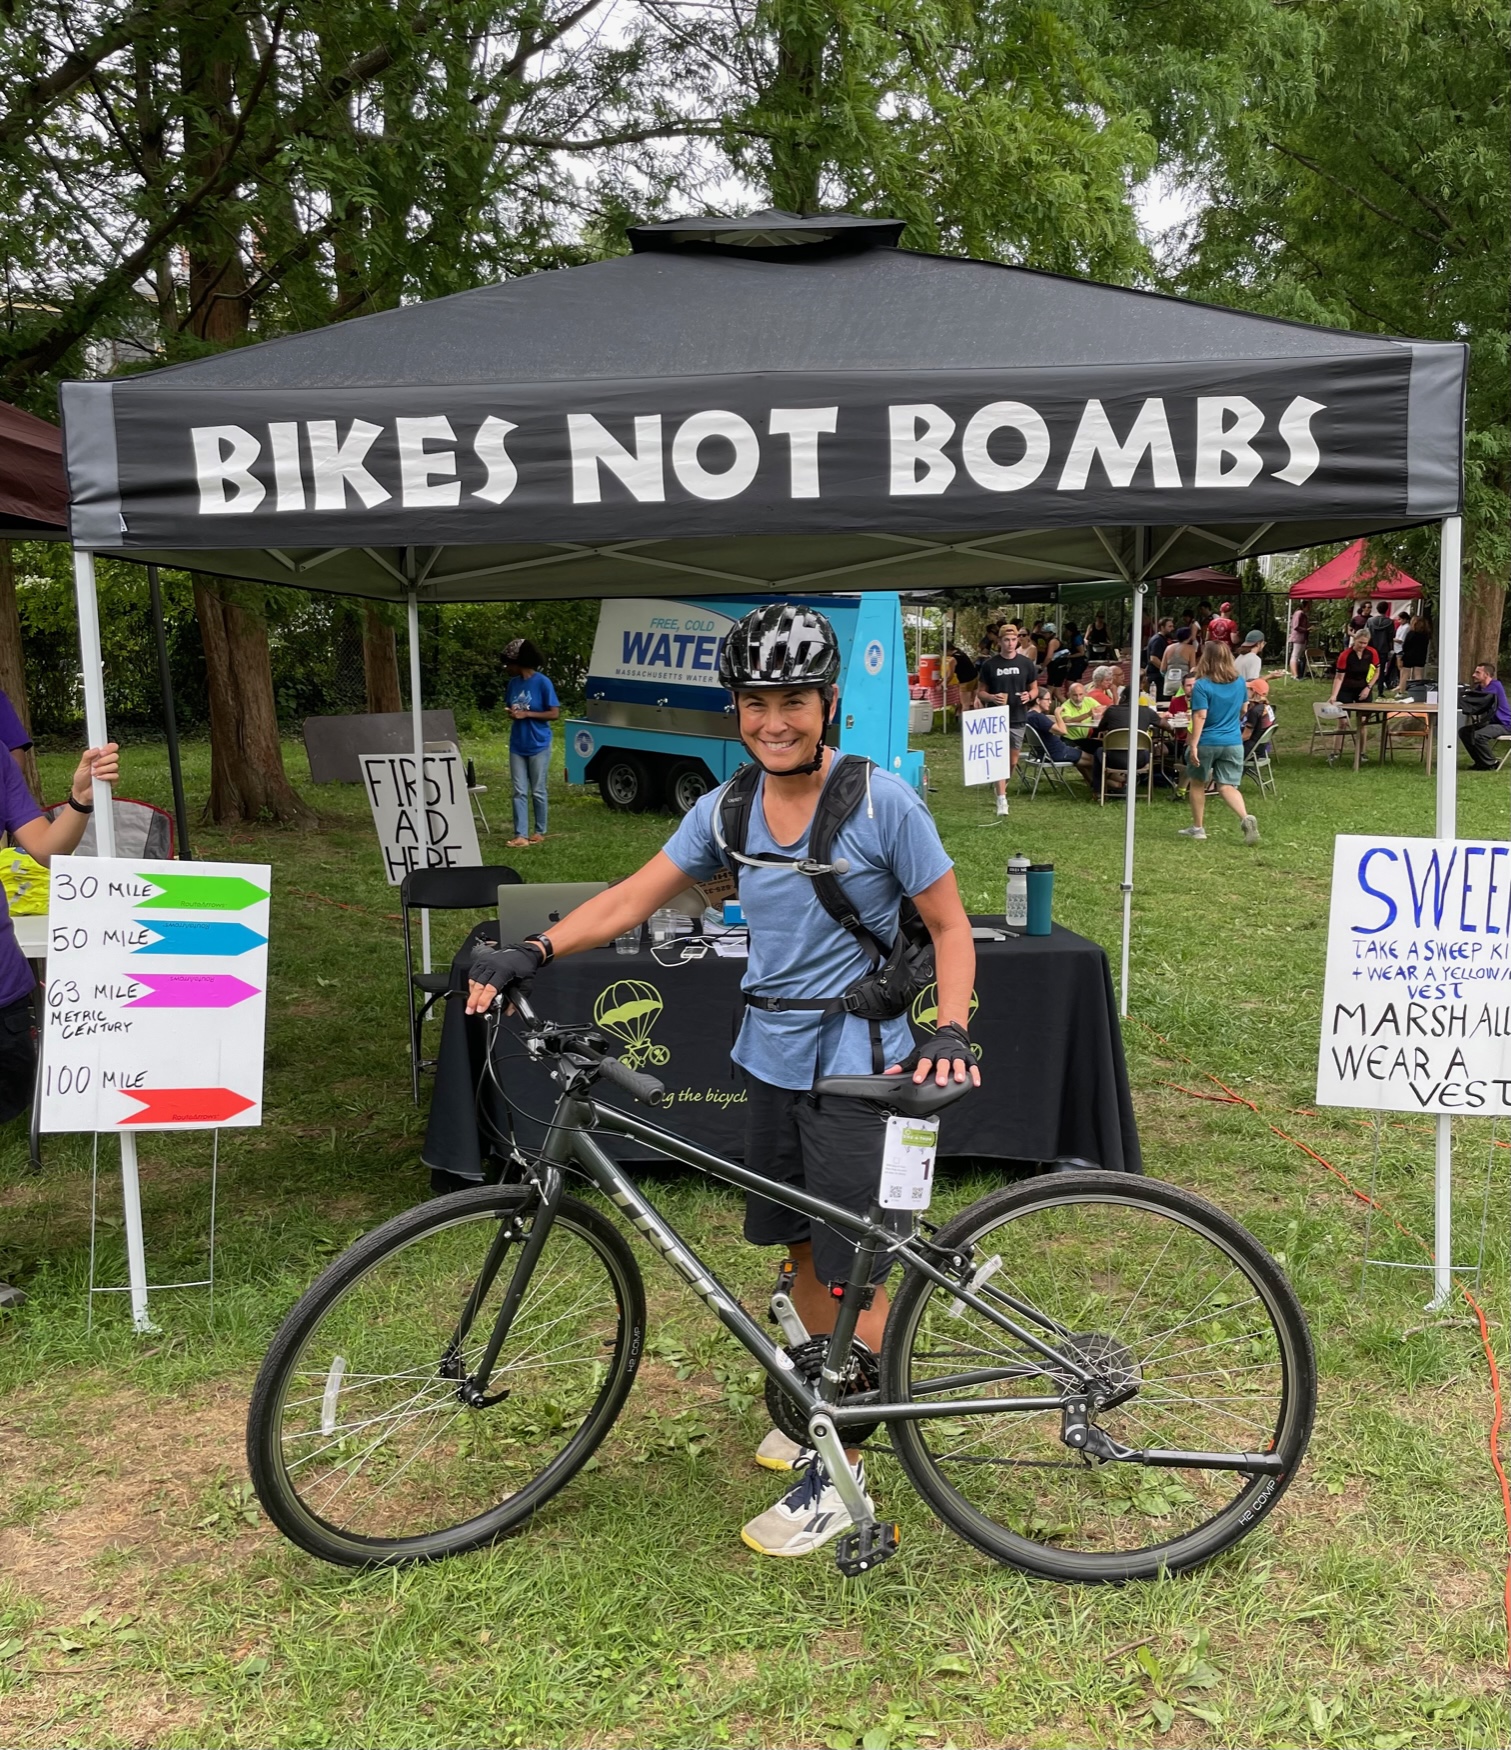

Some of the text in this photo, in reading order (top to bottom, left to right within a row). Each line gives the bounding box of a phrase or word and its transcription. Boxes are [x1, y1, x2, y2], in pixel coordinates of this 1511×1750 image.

[191, 395, 1328, 515] BIKES NOT BOMBS
[649, 617, 715, 632] FREE, COLD
[615, 668, 683, 681] MASSACHUSETTS
[686, 674, 714, 683] WATER
[964, 715, 1008, 736] WATER
[968, 740, 1004, 762] HERE
[364, 756, 457, 808] FIRST
[395, 808, 449, 846] AD
[54, 873, 153, 901] 30 MILE
[52, 926, 150, 952] 50 MILE
[1351, 939, 1399, 960] TAKE
[1407, 940, 1419, 962] A
[1423, 939, 1483, 963] SWEEP
[1367, 964, 1419, 982] WEAR
[1423, 965, 1437, 982] A
[47, 978, 141, 1008] 63 MILE
[1407, 981, 1464, 1001] VEST
[50, 1009, 108, 1026] METRIC
[62, 1021, 134, 1040] CENTURY
[1331, 1043, 1469, 1082] WEAR A
[46, 1064, 149, 1097] 100 MILE
[678, 1086, 704, 1103] the
[705, 1087, 748, 1110] bicycl
[1408, 1079, 1511, 1108] VEST
[921, 1157, 931, 1181] 1
[610, 1177, 737, 1317] TREK
[1237, 1479, 1276, 1526] H2 COMP
